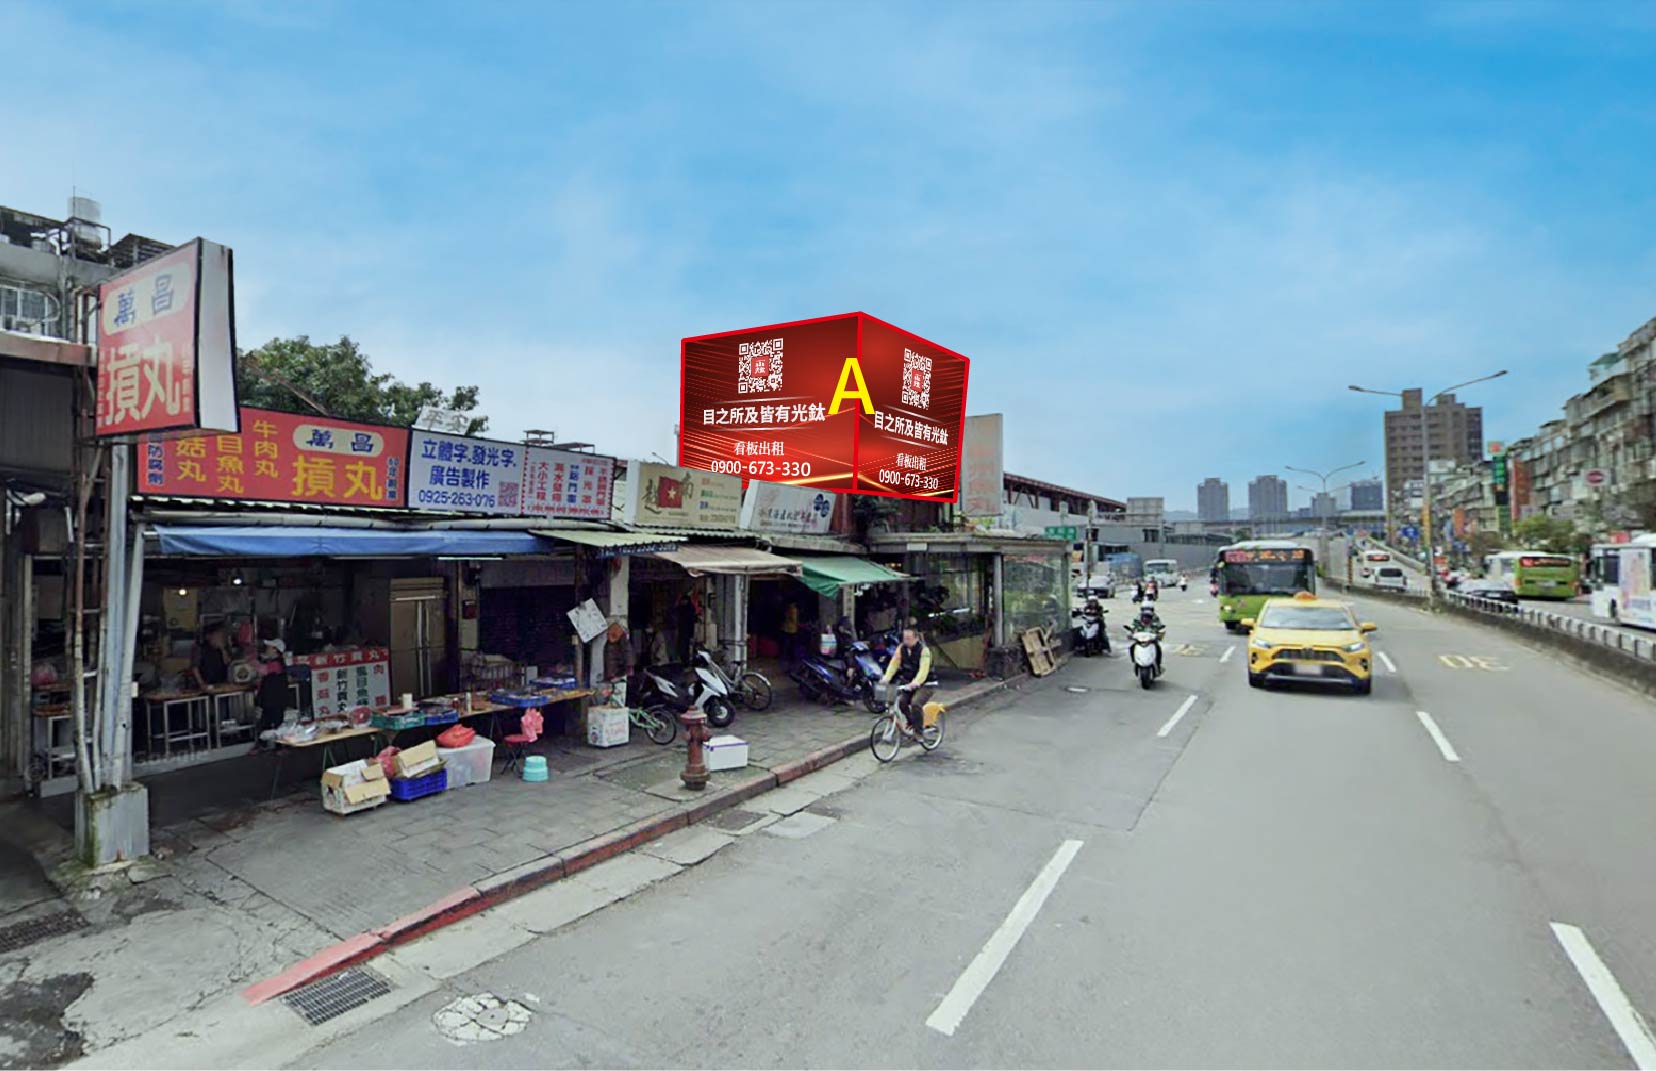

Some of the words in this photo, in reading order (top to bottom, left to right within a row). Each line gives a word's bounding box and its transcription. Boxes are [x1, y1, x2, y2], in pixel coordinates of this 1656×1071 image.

[113, 273, 174, 328] 萬昌
[253, 420, 279, 478] 牛肉丸
[305, 428, 375, 453] 萬昌
[429, 465, 490, 491] 廣告製作
[418, 489, 496, 508] 0925-263-076
